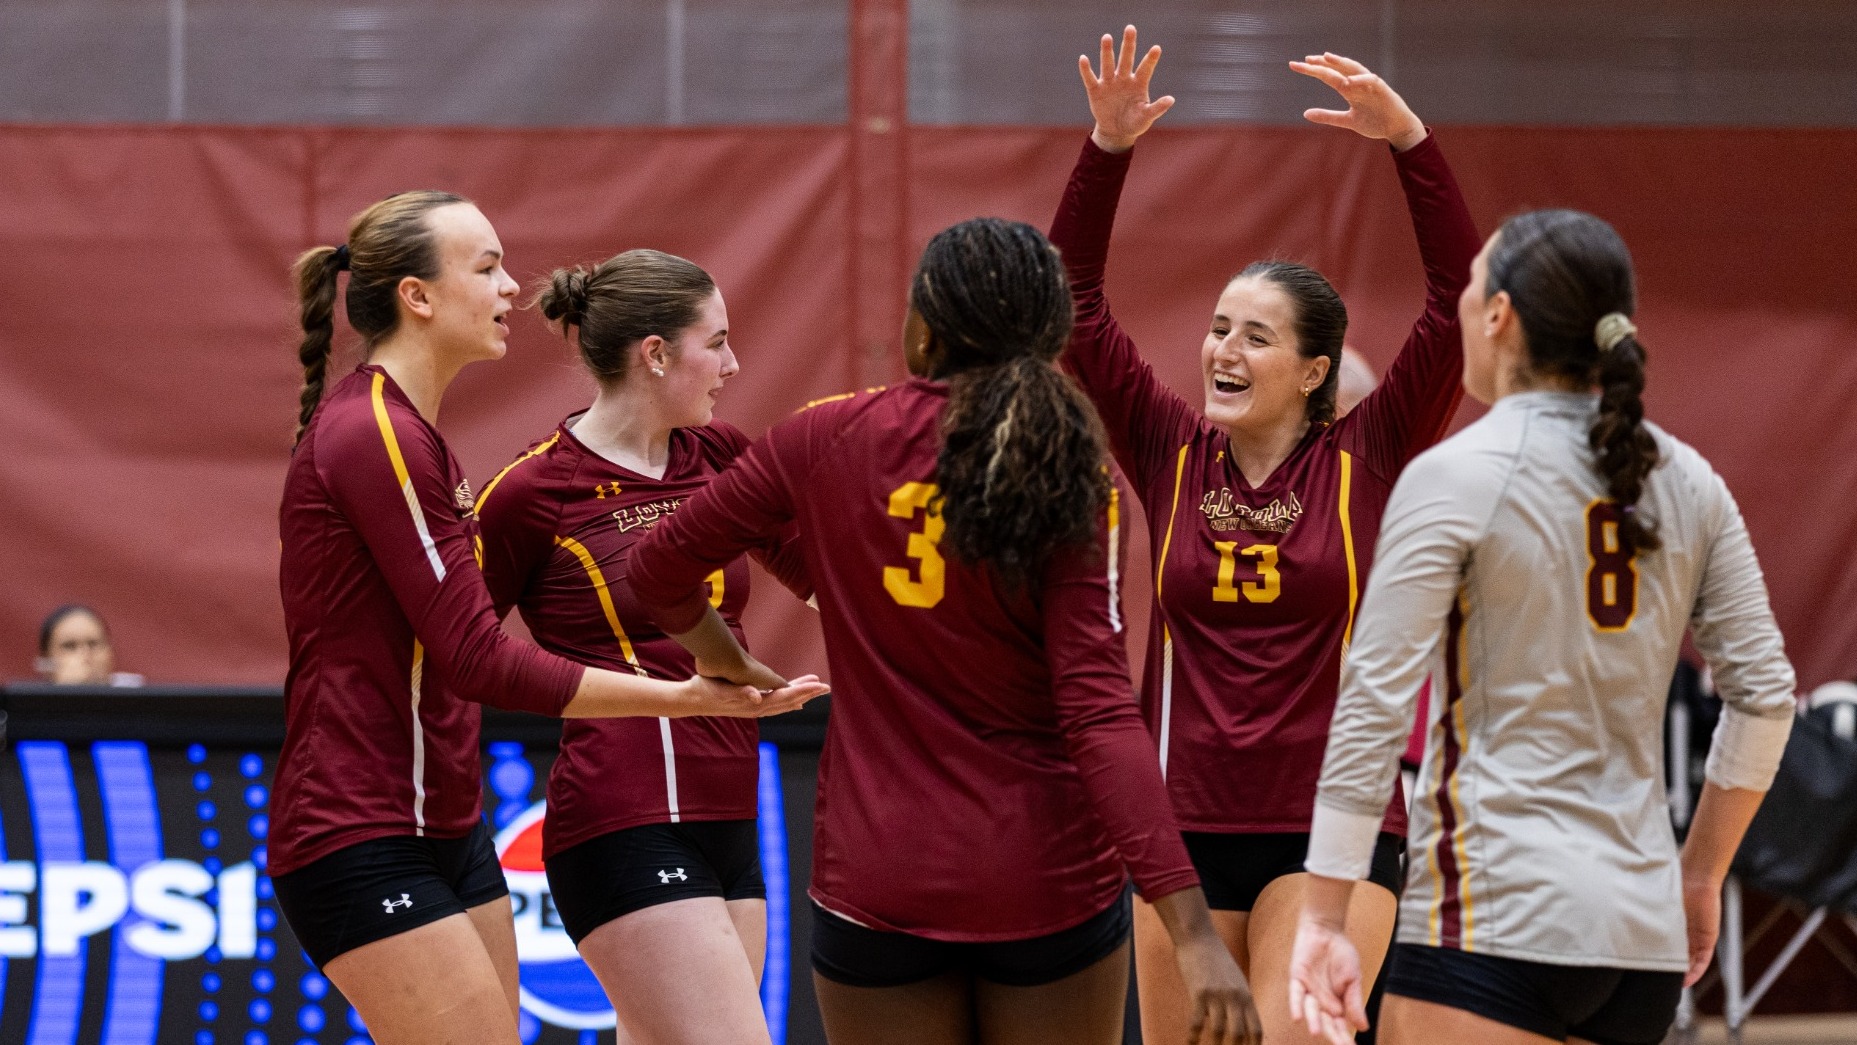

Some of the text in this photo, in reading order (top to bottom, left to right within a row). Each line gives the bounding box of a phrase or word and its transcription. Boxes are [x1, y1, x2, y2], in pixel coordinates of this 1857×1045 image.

[883, 481, 946, 609] 3
[1210, 517, 1240, 531] NEW
[1584, 497, 1640, 633] 8
[1212, 541, 1281, 603] 13
